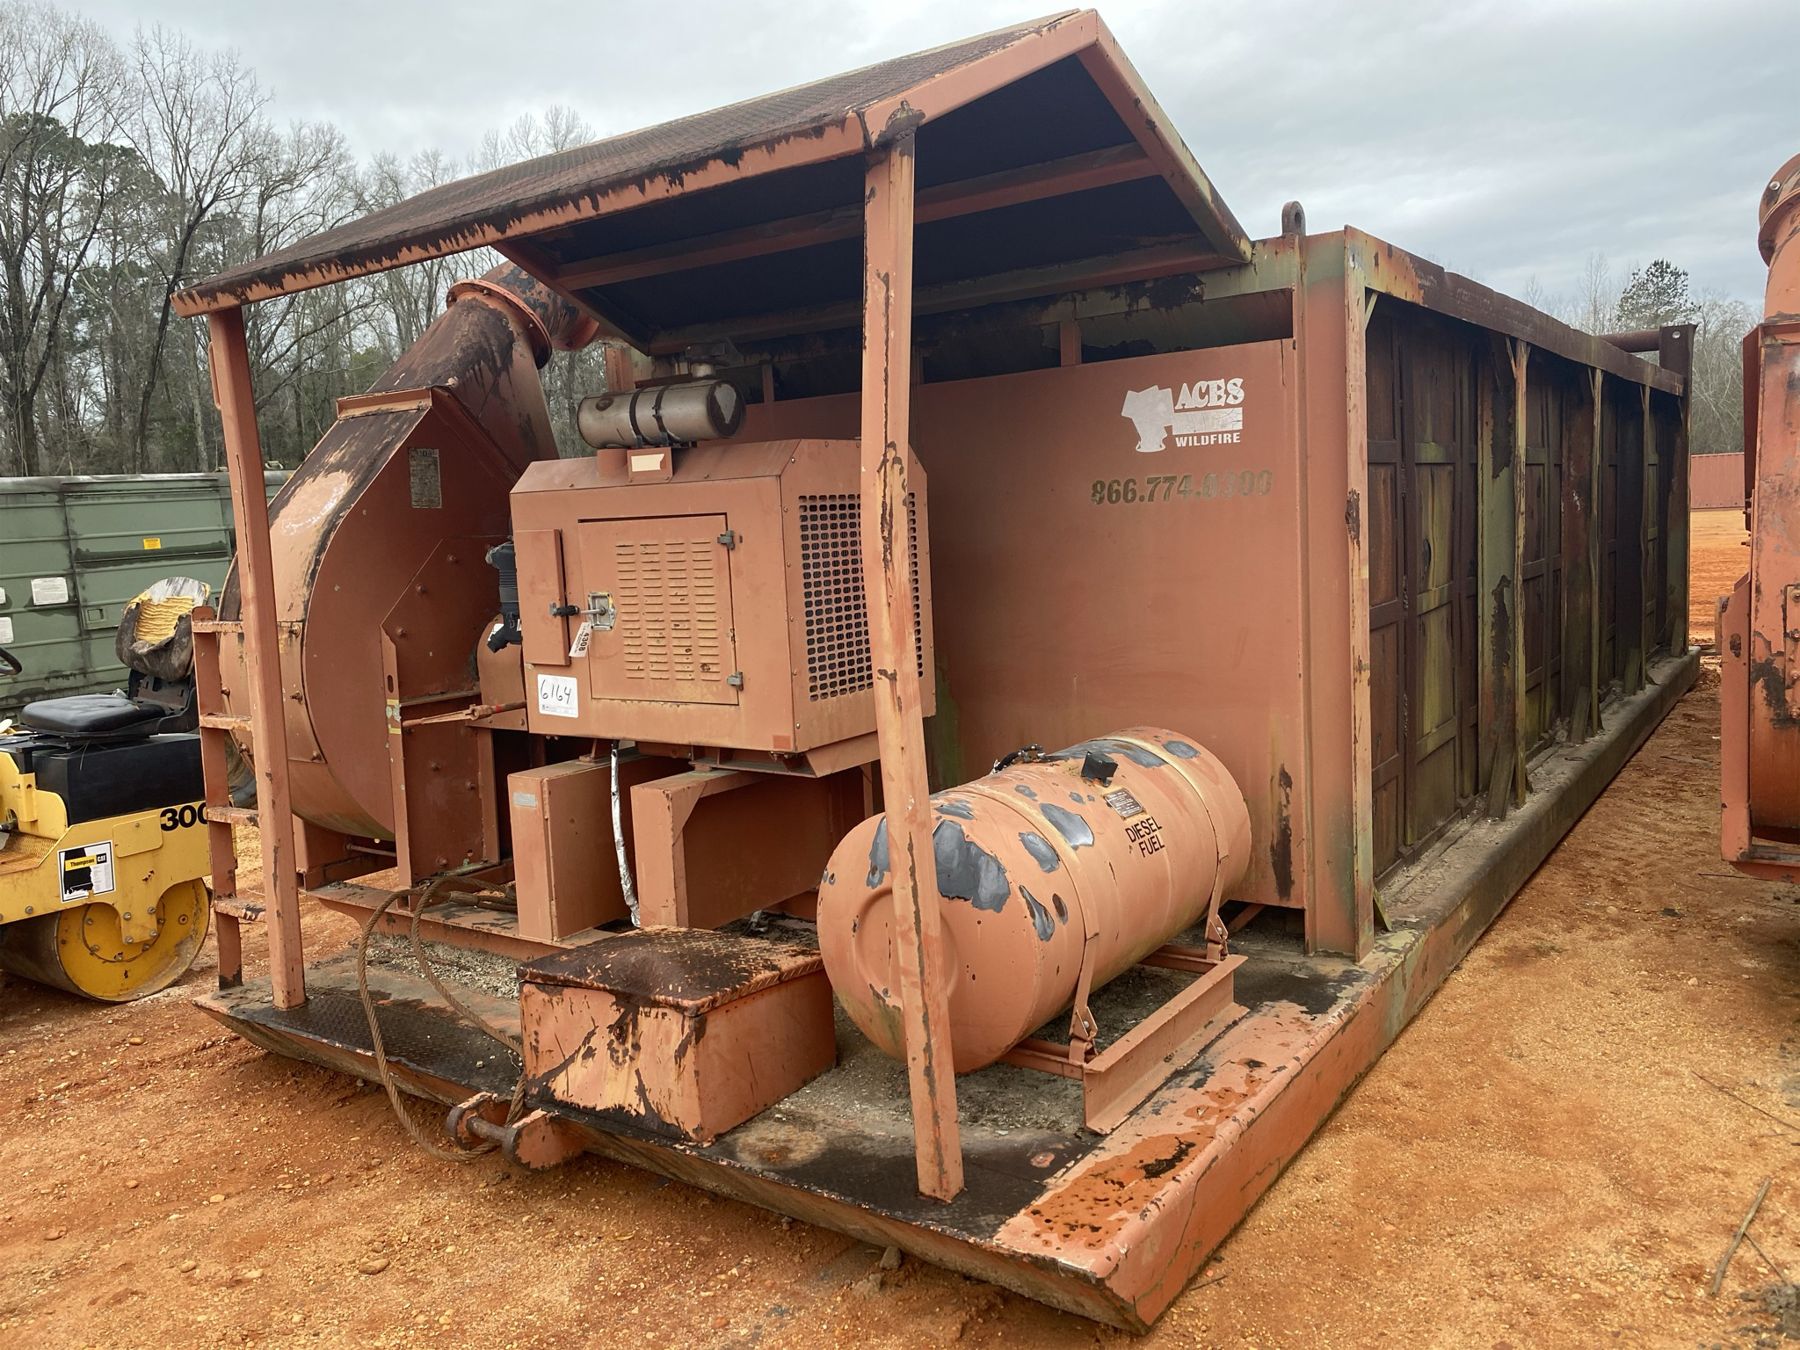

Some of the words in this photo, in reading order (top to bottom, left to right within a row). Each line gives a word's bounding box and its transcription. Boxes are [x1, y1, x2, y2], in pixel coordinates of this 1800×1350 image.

[1174, 377, 1245, 410] ACES
[1175, 432, 1241, 447] WILDFIRE
[540, 679, 572, 705] 6164
[1125, 816, 1163, 843] DIESEL
[1138, 836, 1165, 858] FUEL
